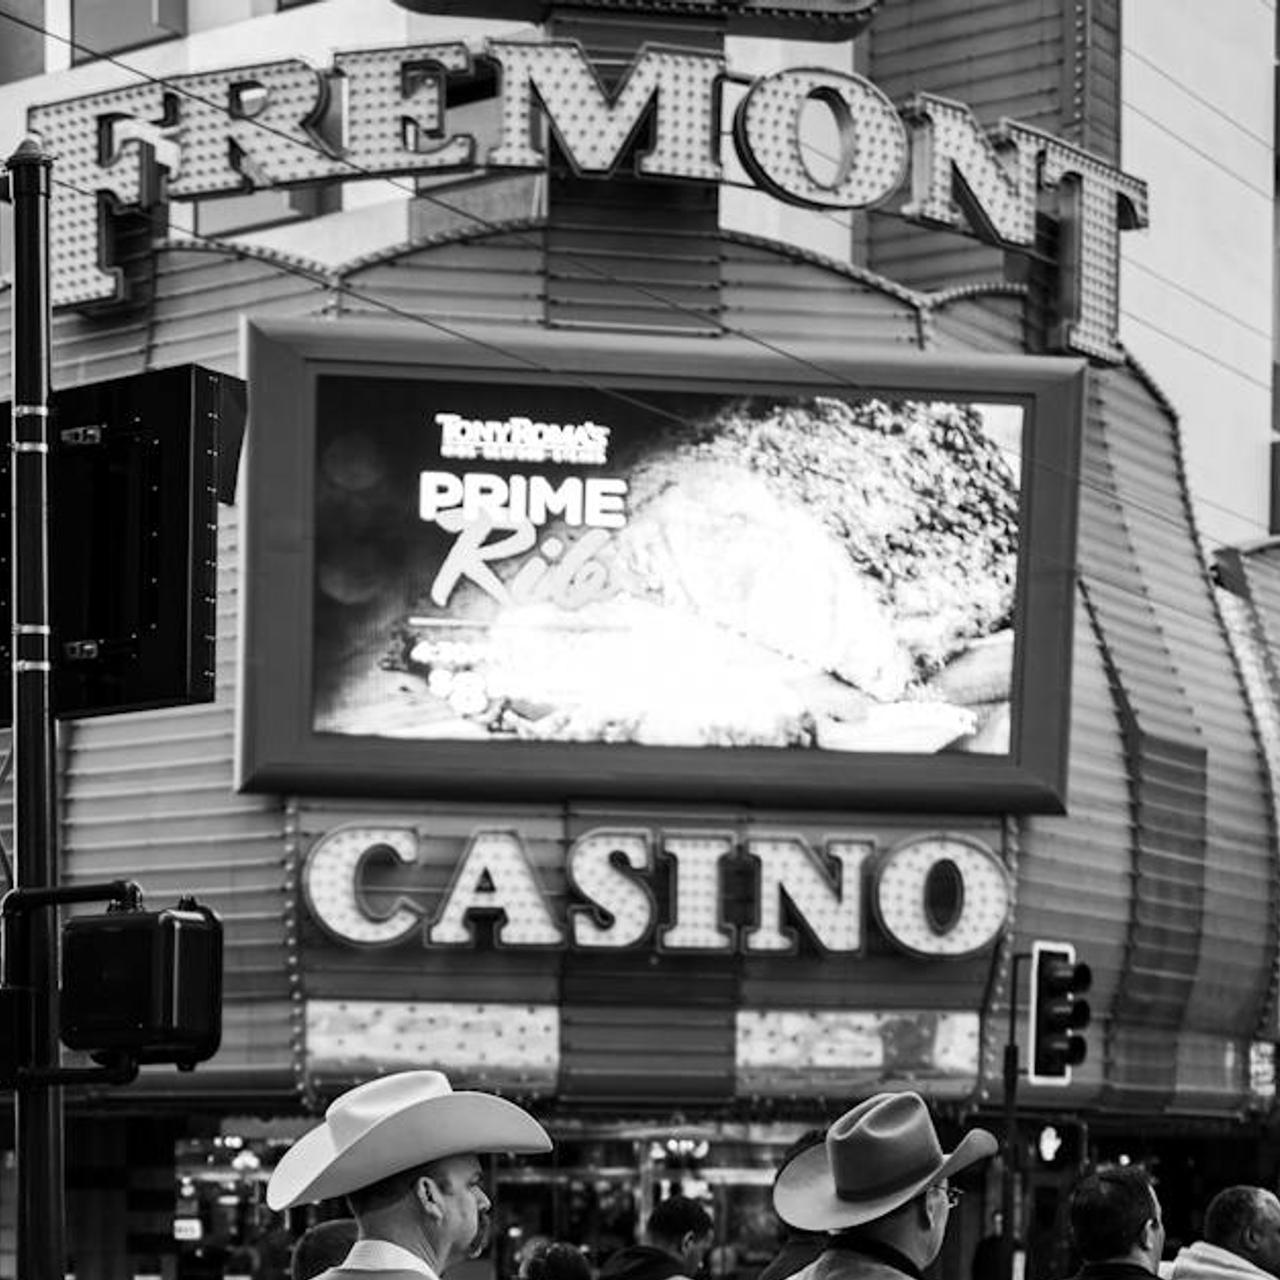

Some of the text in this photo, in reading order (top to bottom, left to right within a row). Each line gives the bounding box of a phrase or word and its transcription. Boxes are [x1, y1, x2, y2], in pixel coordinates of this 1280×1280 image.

[26, 38, 1148, 366] FREMONT
[420, 471, 628, 528] PRIME
[305, 826, 1012, 955] CASINO
